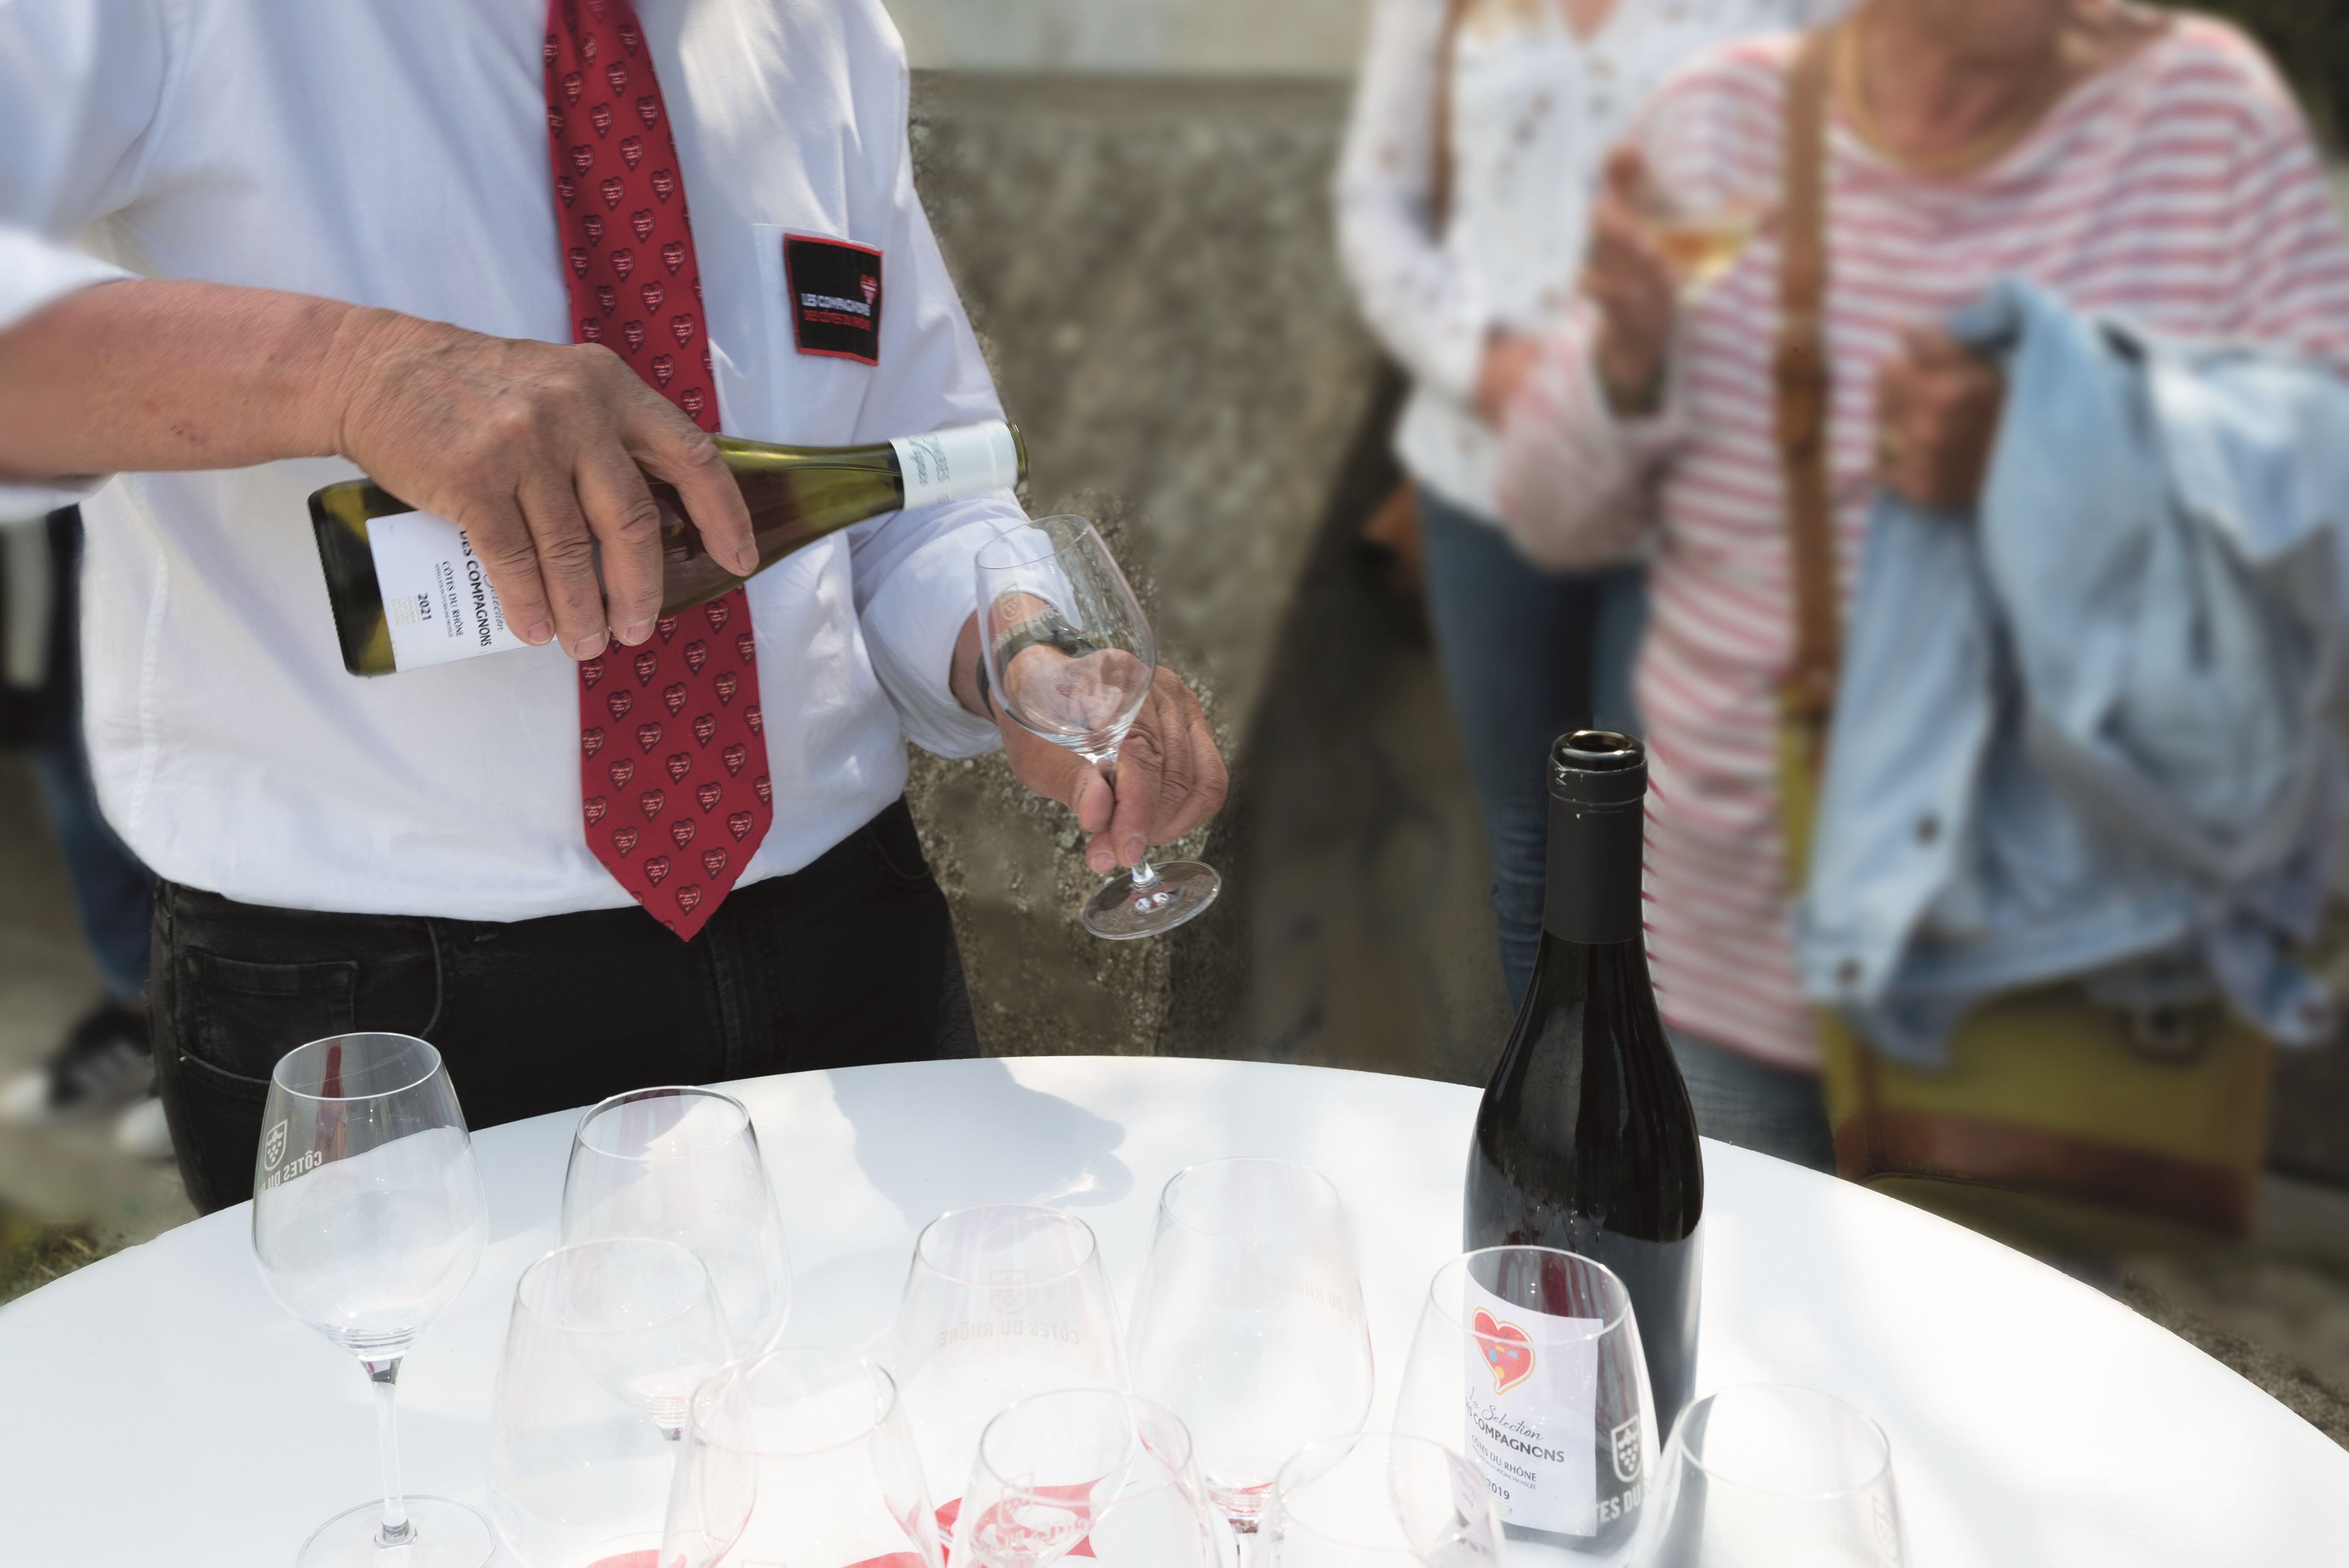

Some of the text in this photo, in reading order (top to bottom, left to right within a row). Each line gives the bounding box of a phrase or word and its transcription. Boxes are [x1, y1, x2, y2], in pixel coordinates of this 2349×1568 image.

[418, 592, 432, 621] 2021
[442, 561, 464, 637] CÔTES DU RHÔNE
[466, 560, 492, 647] COMPAGNONS
[1474, 1413, 1565, 1463] COMPAGNONS
[1482, 1405, 1543, 1441] Selection
[1472, 1435, 1537, 1482] CÔTES DU RHÔNE
